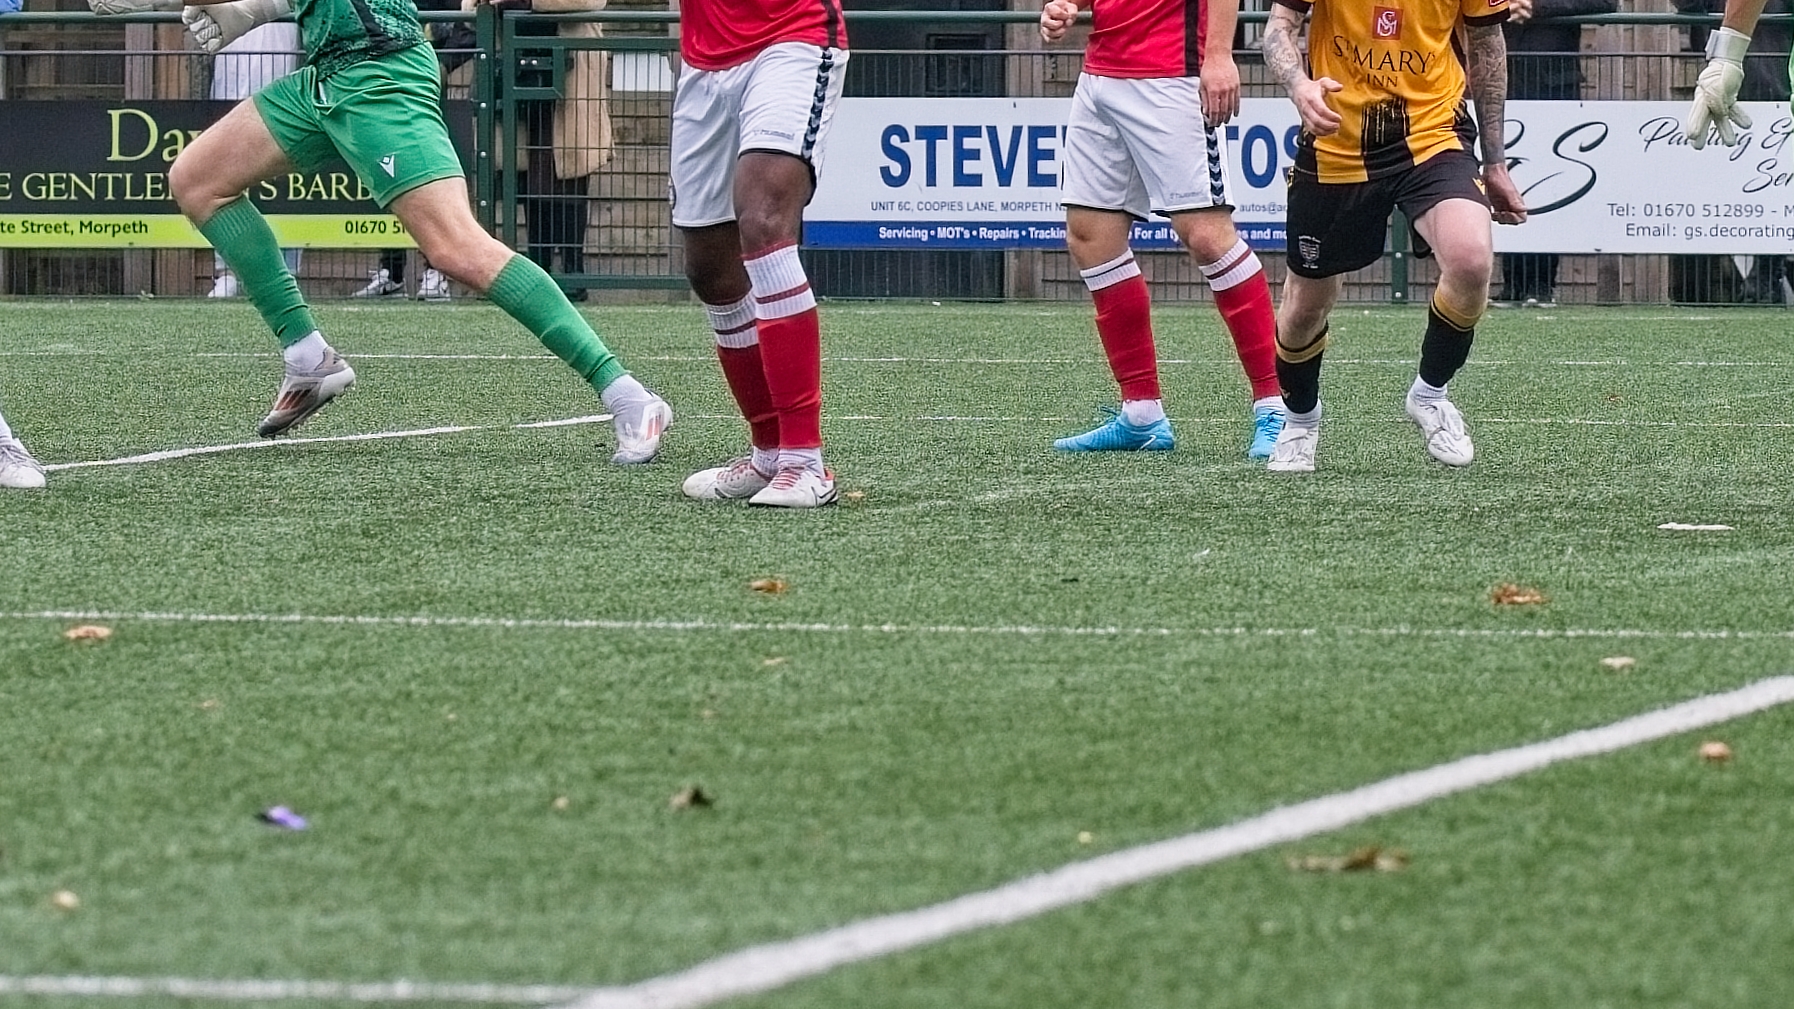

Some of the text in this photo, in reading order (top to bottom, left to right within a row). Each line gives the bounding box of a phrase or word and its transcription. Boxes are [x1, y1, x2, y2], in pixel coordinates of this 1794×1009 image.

[1367, 73, 1398, 88] INN
[879, 124, 1068, 188] STEVE'
[871, 201, 895, 211] UNIT
[898, 201, 914, 213] 6C,
[916, 201, 962, 212] COOPIES
[967, 202, 997, 213] LANE,
[1000, 202, 1051, 212] MORPETH
[1607, 203, 1636, 217] Tel:
[1643, 203, 1695, 217] 01670
[1702, 204, 1764, 217] 512899
[0, 220, 148, 238] te Street, Morpeth
[345, 221, 387, 234] 01670
[879, 227, 1067, 241] Servicing MOT's Repairs Trackin
[1134, 227, 1153, 240] For
[1154, 227, 1168, 240] all
[1250, 228, 1271, 240] and
[1626, 223, 1676, 238] Email:
